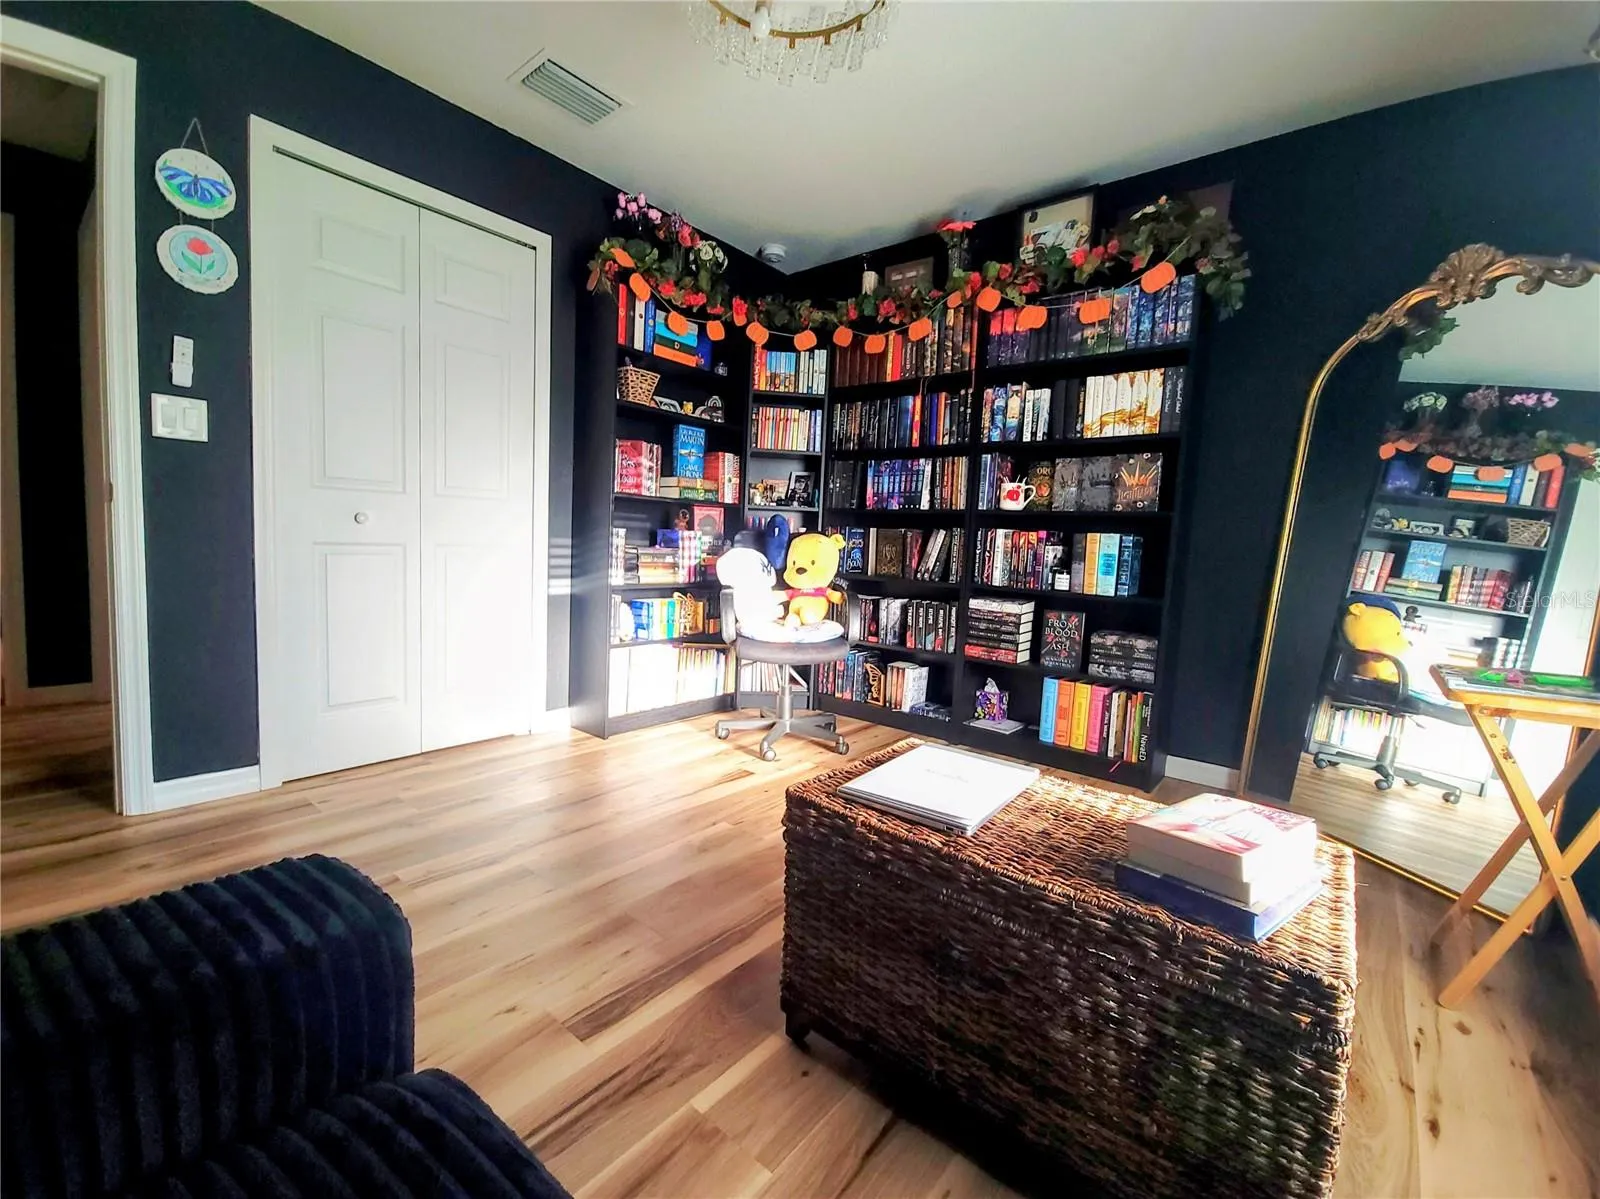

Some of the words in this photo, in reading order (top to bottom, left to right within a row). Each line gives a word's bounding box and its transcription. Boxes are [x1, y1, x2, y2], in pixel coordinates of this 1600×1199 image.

[1048, 618, 1076, 629] FROM
[1045, 627, 1078, 637] BLOOD
[1050, 640, 1070, 651] ASH
[1140, 735, 1148, 760] NavaED
